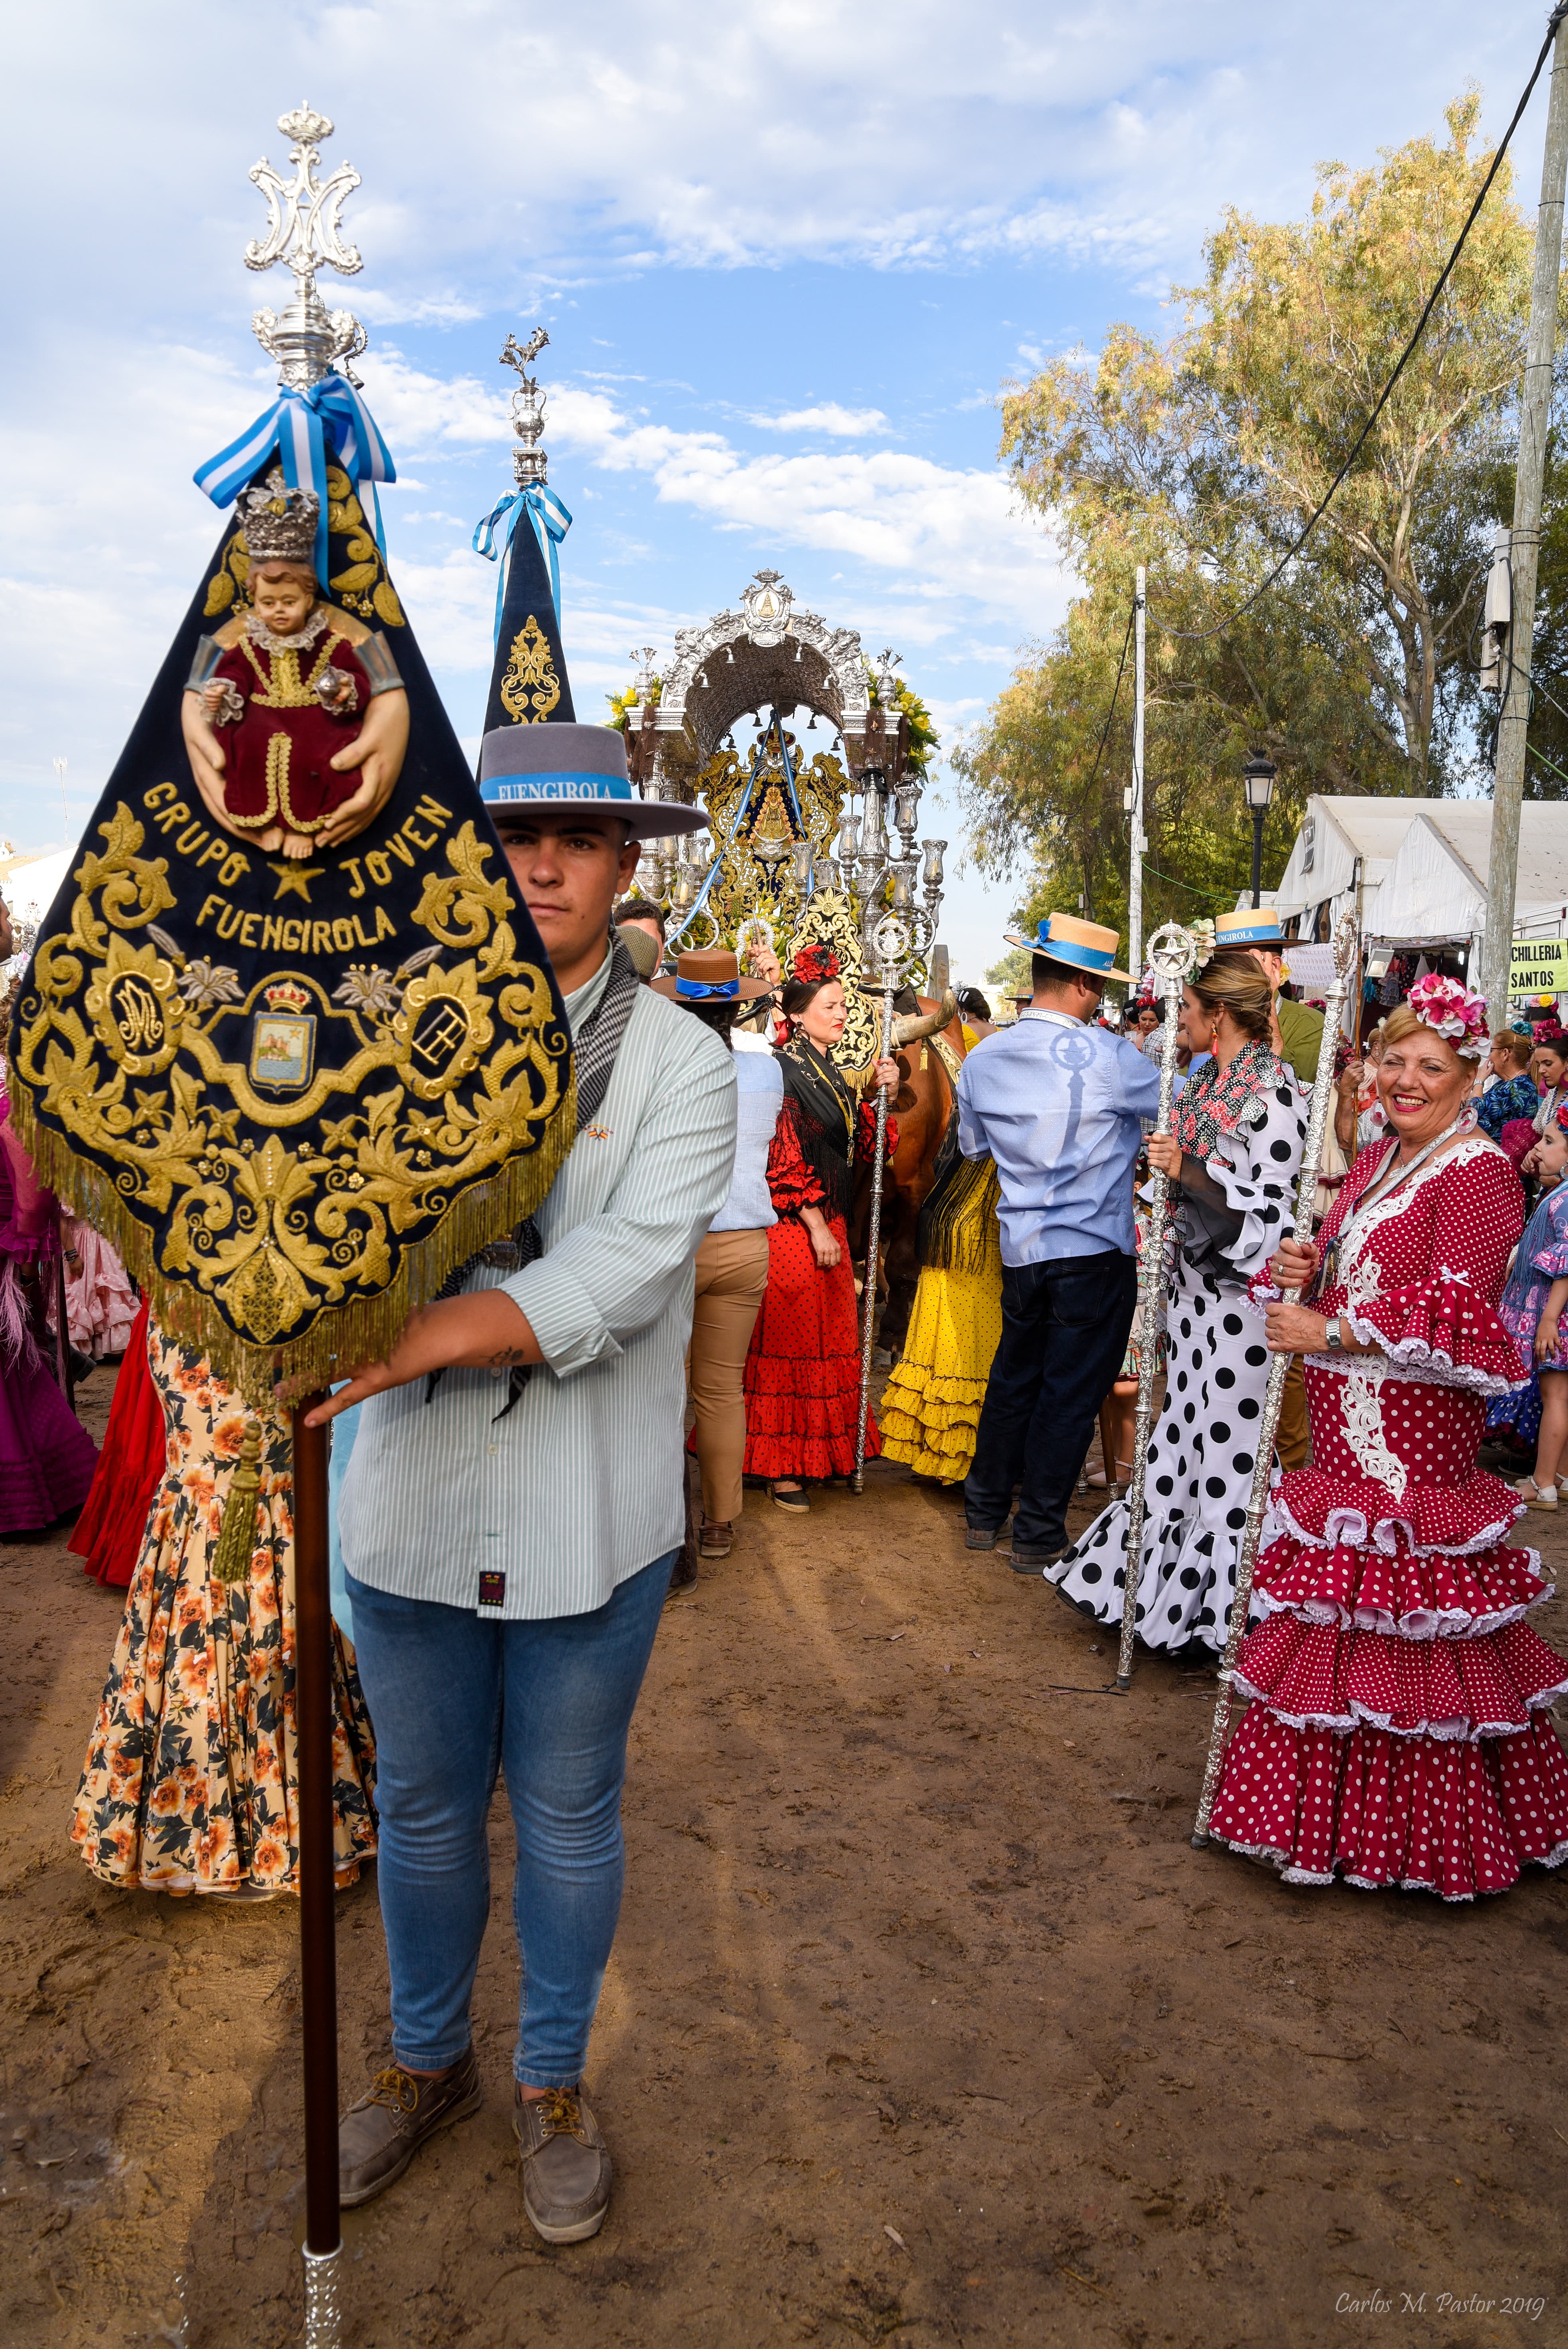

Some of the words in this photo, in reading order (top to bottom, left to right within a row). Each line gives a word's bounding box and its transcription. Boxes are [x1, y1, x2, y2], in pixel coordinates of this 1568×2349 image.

[498, 782, 612, 799] FUENGIROLA
[144, 782, 251, 886] GRUPO
[339, 794, 453, 898] JOVEN
[196, 894, 397, 955] FUENGIROLA
[1511, 971, 1554, 988] SANTOS
